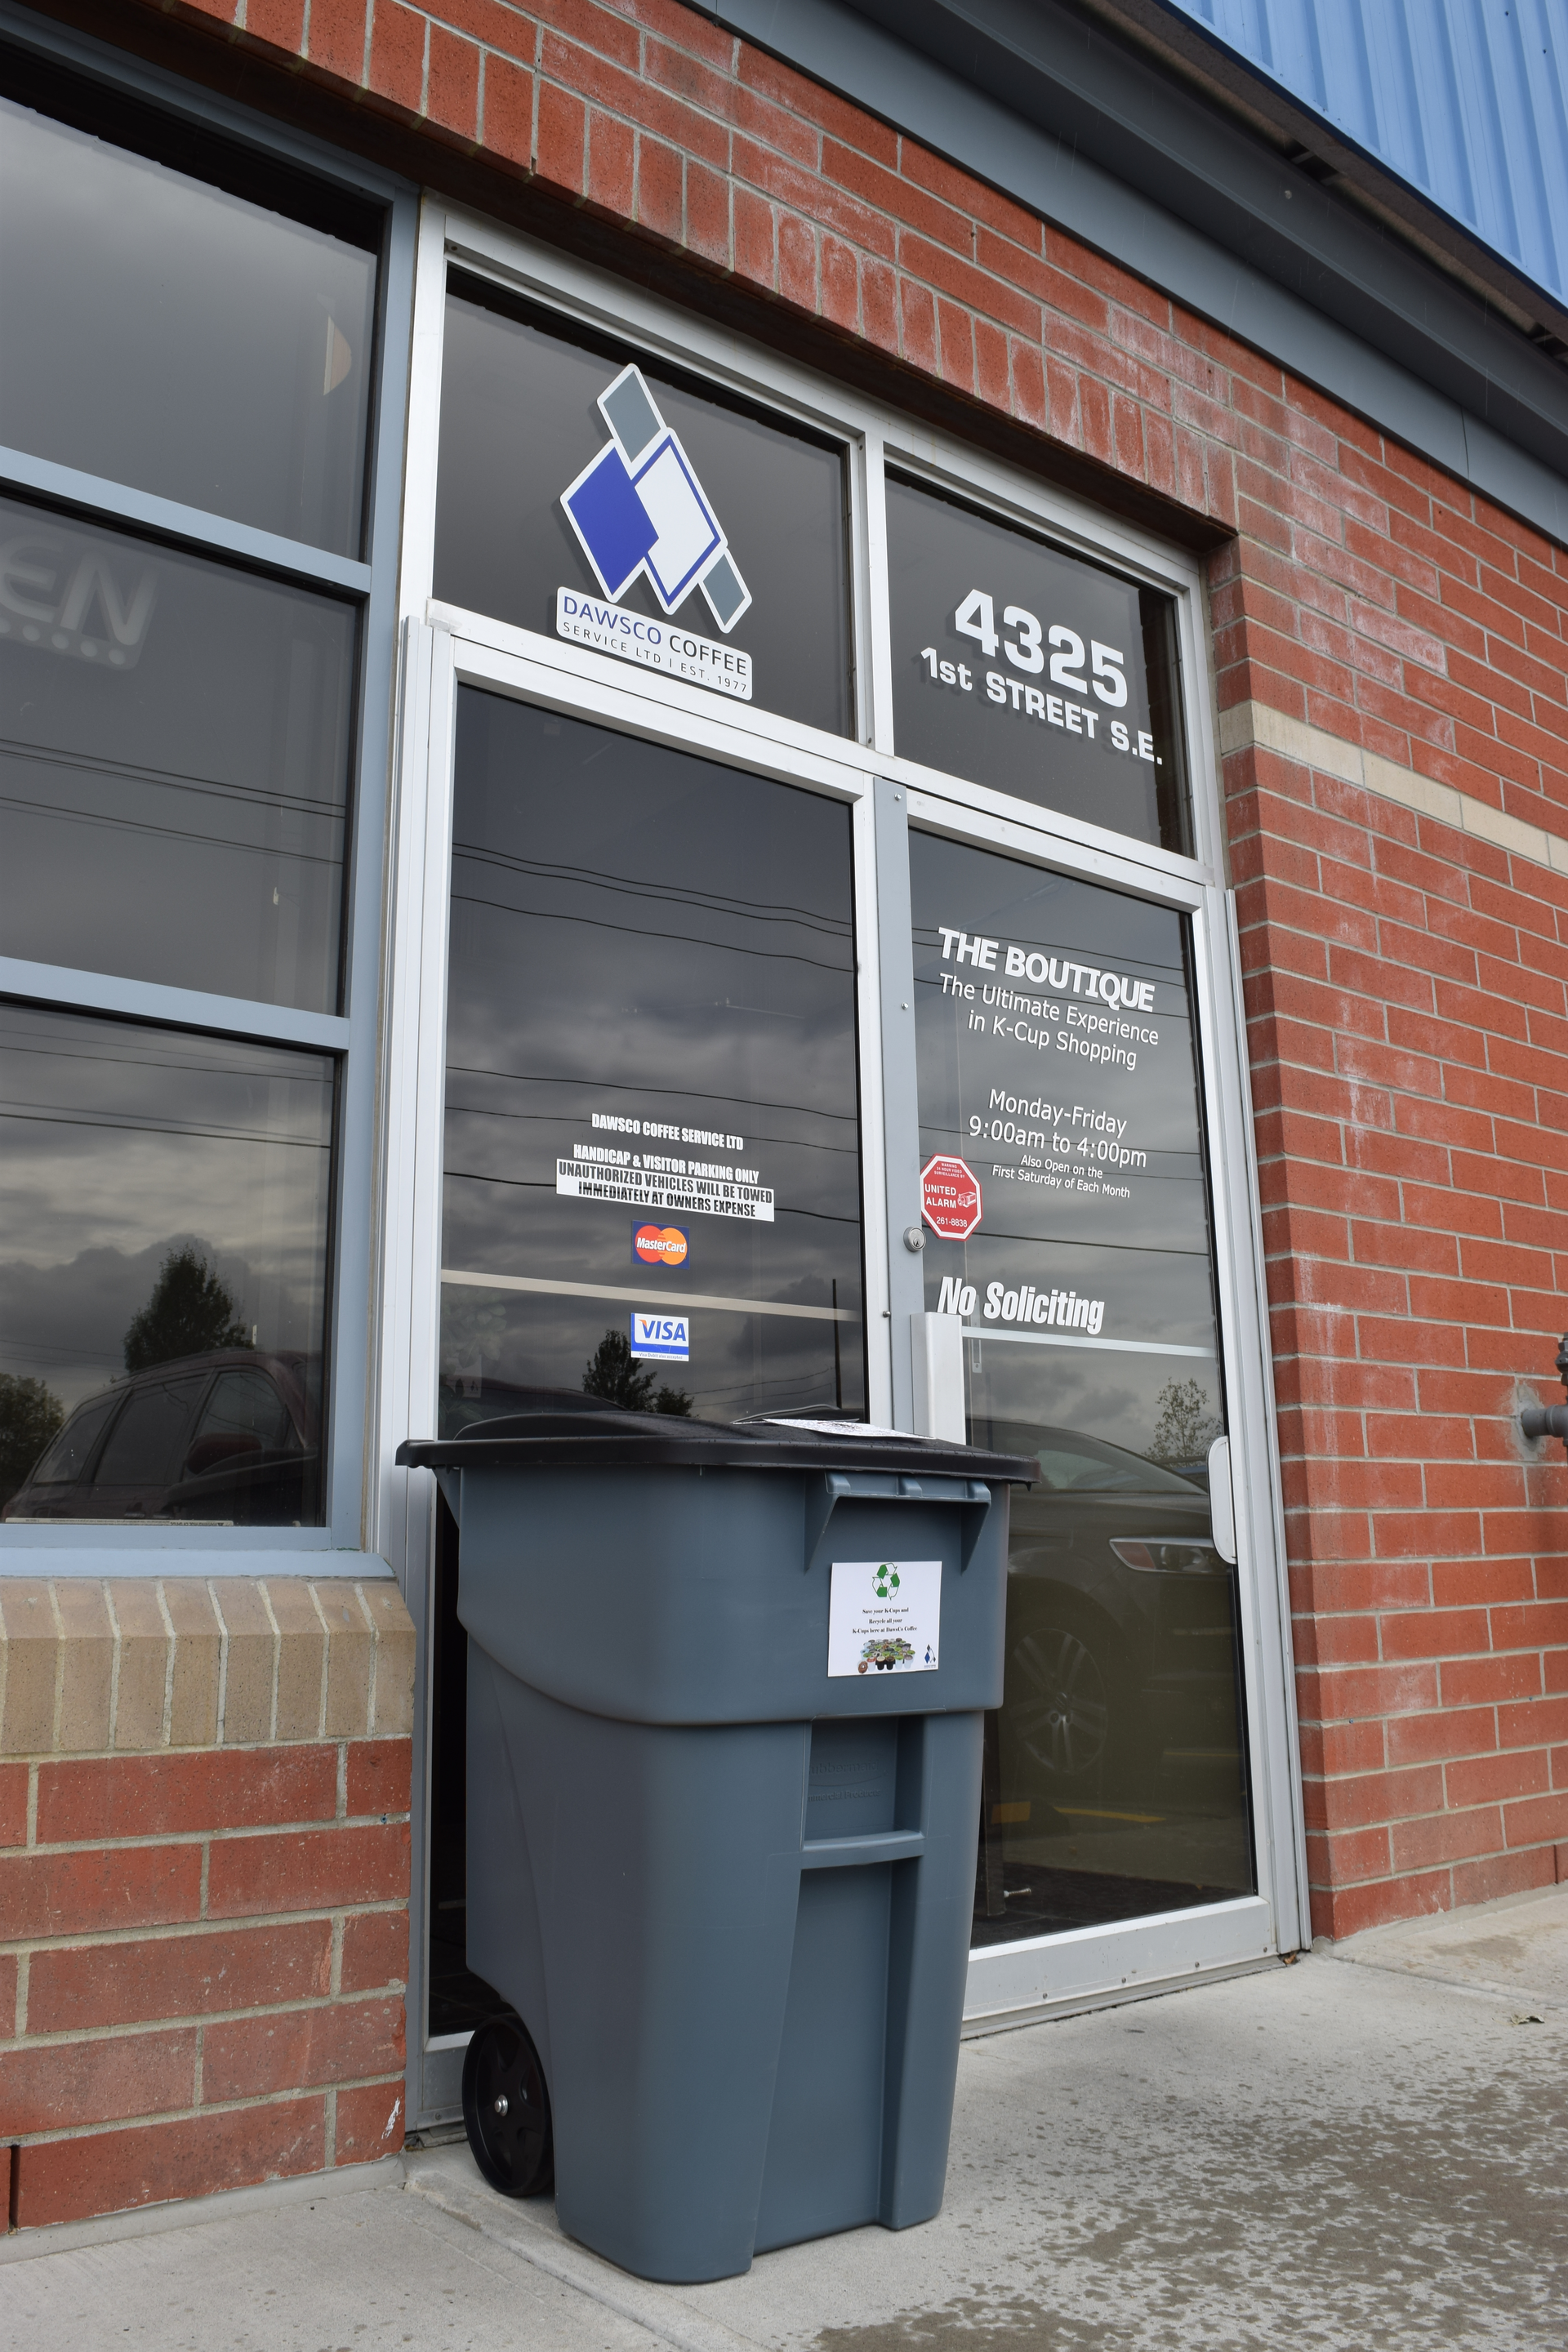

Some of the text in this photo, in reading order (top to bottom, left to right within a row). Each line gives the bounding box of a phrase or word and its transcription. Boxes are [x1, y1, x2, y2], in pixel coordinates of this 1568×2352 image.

[564, 595, 747, 676] DAWSCO COFFEE
[564, 621, 627, 653] SERVICE
[635, 647, 661, 664] LTD
[681, 662, 710, 682] EST.
[717, 675, 747, 693] 1977
[955, 589, 1128, 708] 4325
[920, 647, 1163, 765] 1st STREET S.E.
[938, 926, 1156, 1013] THE BOUTIQUE
[940, 973, 1159, 1045] The Ultimate Experience
[968, 1009, 1137, 1071] in K-Cup Shopping
[592, 1113, 743, 1151] DAWSCO COFFEE SERVICE LTD
[988, 1089, 1127, 1138] Monday-Friday
[573, 1143, 760, 1185] HANDICAP & VISITOR PARKING ONLY
[969, 1115, 1147, 1169] 9:00am to 4:00pm
[559, 1160, 773, 1205] UNAUTHORIZED VEHICLES WILL BE TOWED
[924, 1183, 956, 1196] UNITED
[992, 1165, 1130, 1199] First Saturday of Each Month
[1021, 1155, 1103, 1179] Also Open on the
[578, 1181, 755, 1218] IMMEDIATELY AT OWNERS EXPENSE
[926, 1196, 956, 1209] ALARM
[936, 1216, 967, 1227] 261-8838
[636, 1236, 686, 1254] MasterCard
[937, 1276, 1105, 1335] No Soliciting
[639, 1319, 686, 1341] VISA
